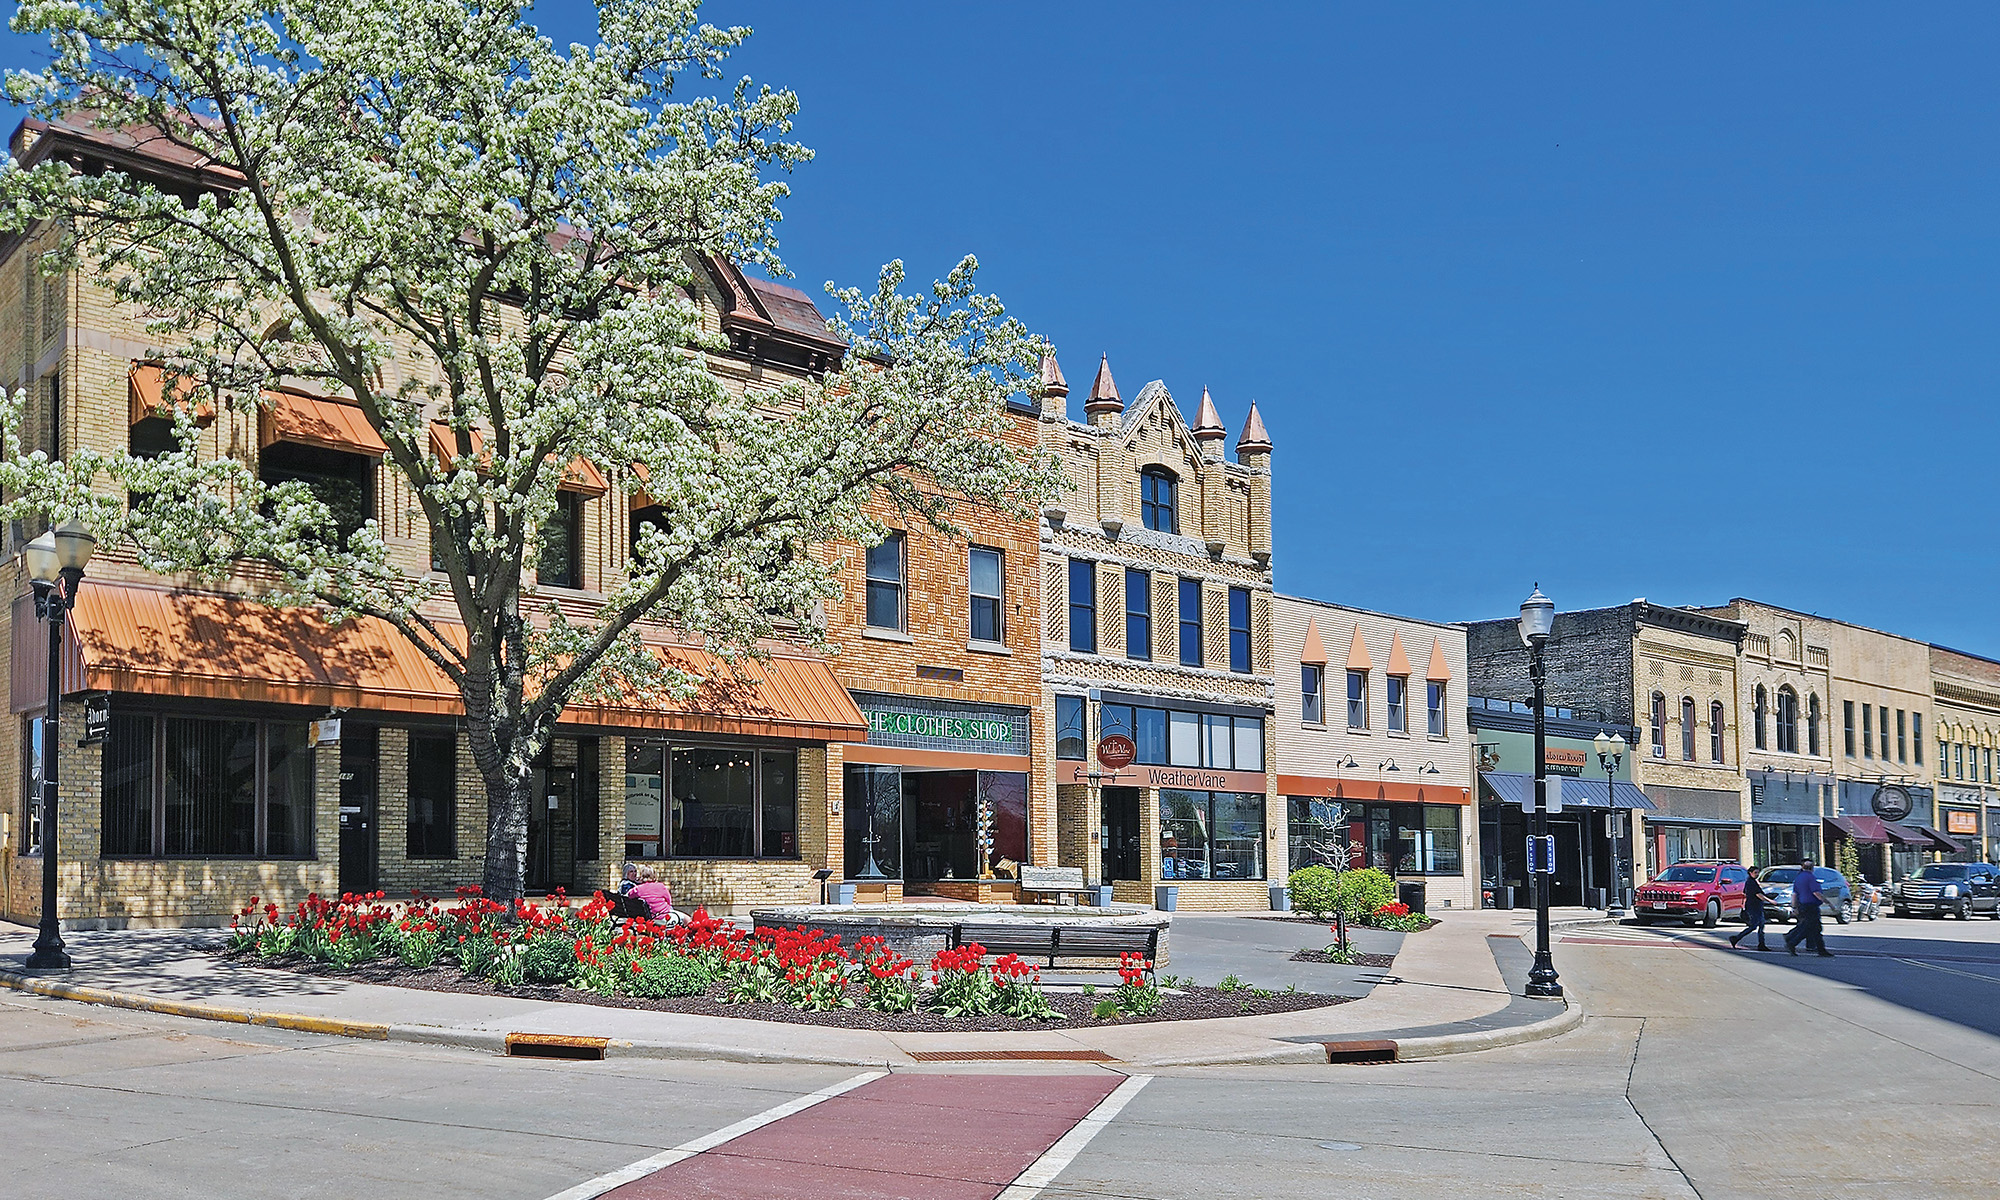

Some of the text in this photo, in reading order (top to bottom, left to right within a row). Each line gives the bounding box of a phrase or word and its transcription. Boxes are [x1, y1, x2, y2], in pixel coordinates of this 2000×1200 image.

[896, 715, 963, 737] CLOTHES
[970, 721, 1008, 741] SHOP
[1148, 769, 1226, 788] WeatherVane
